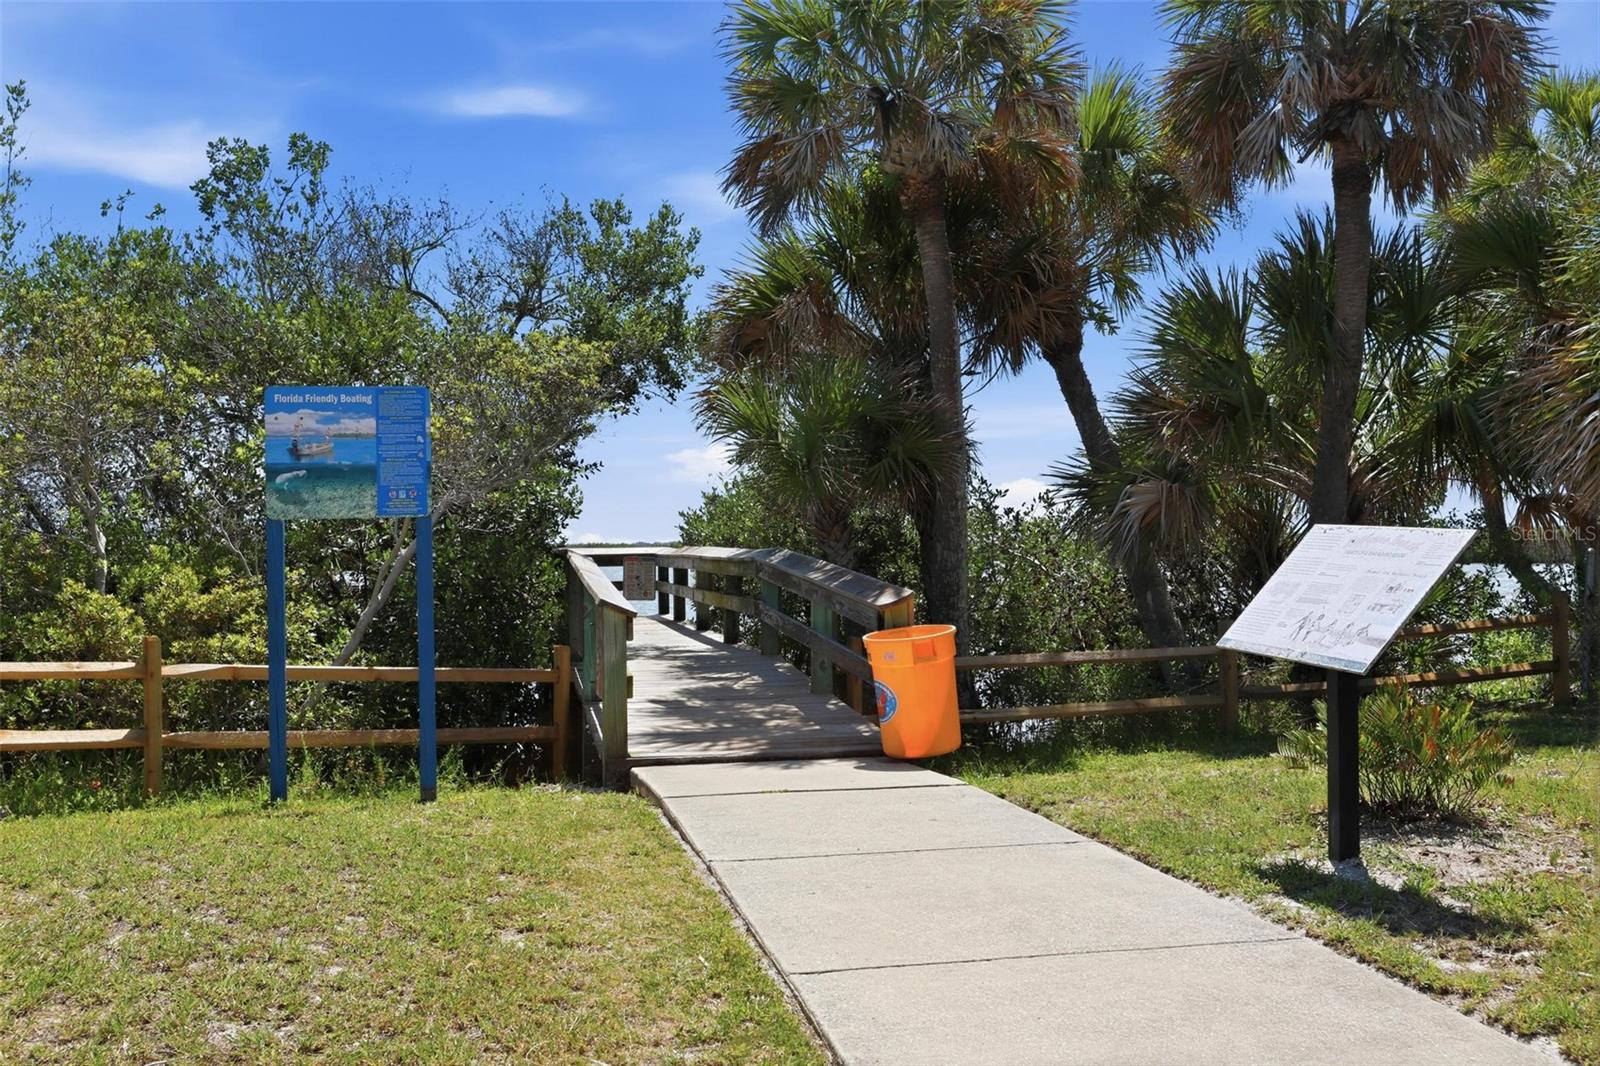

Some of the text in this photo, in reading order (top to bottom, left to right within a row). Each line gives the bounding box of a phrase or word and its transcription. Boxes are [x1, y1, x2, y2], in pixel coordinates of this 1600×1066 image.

[274, 394, 304, 403] Florida
[305, 394, 338, 405] Friendly
[340, 394, 373, 405] Boating
